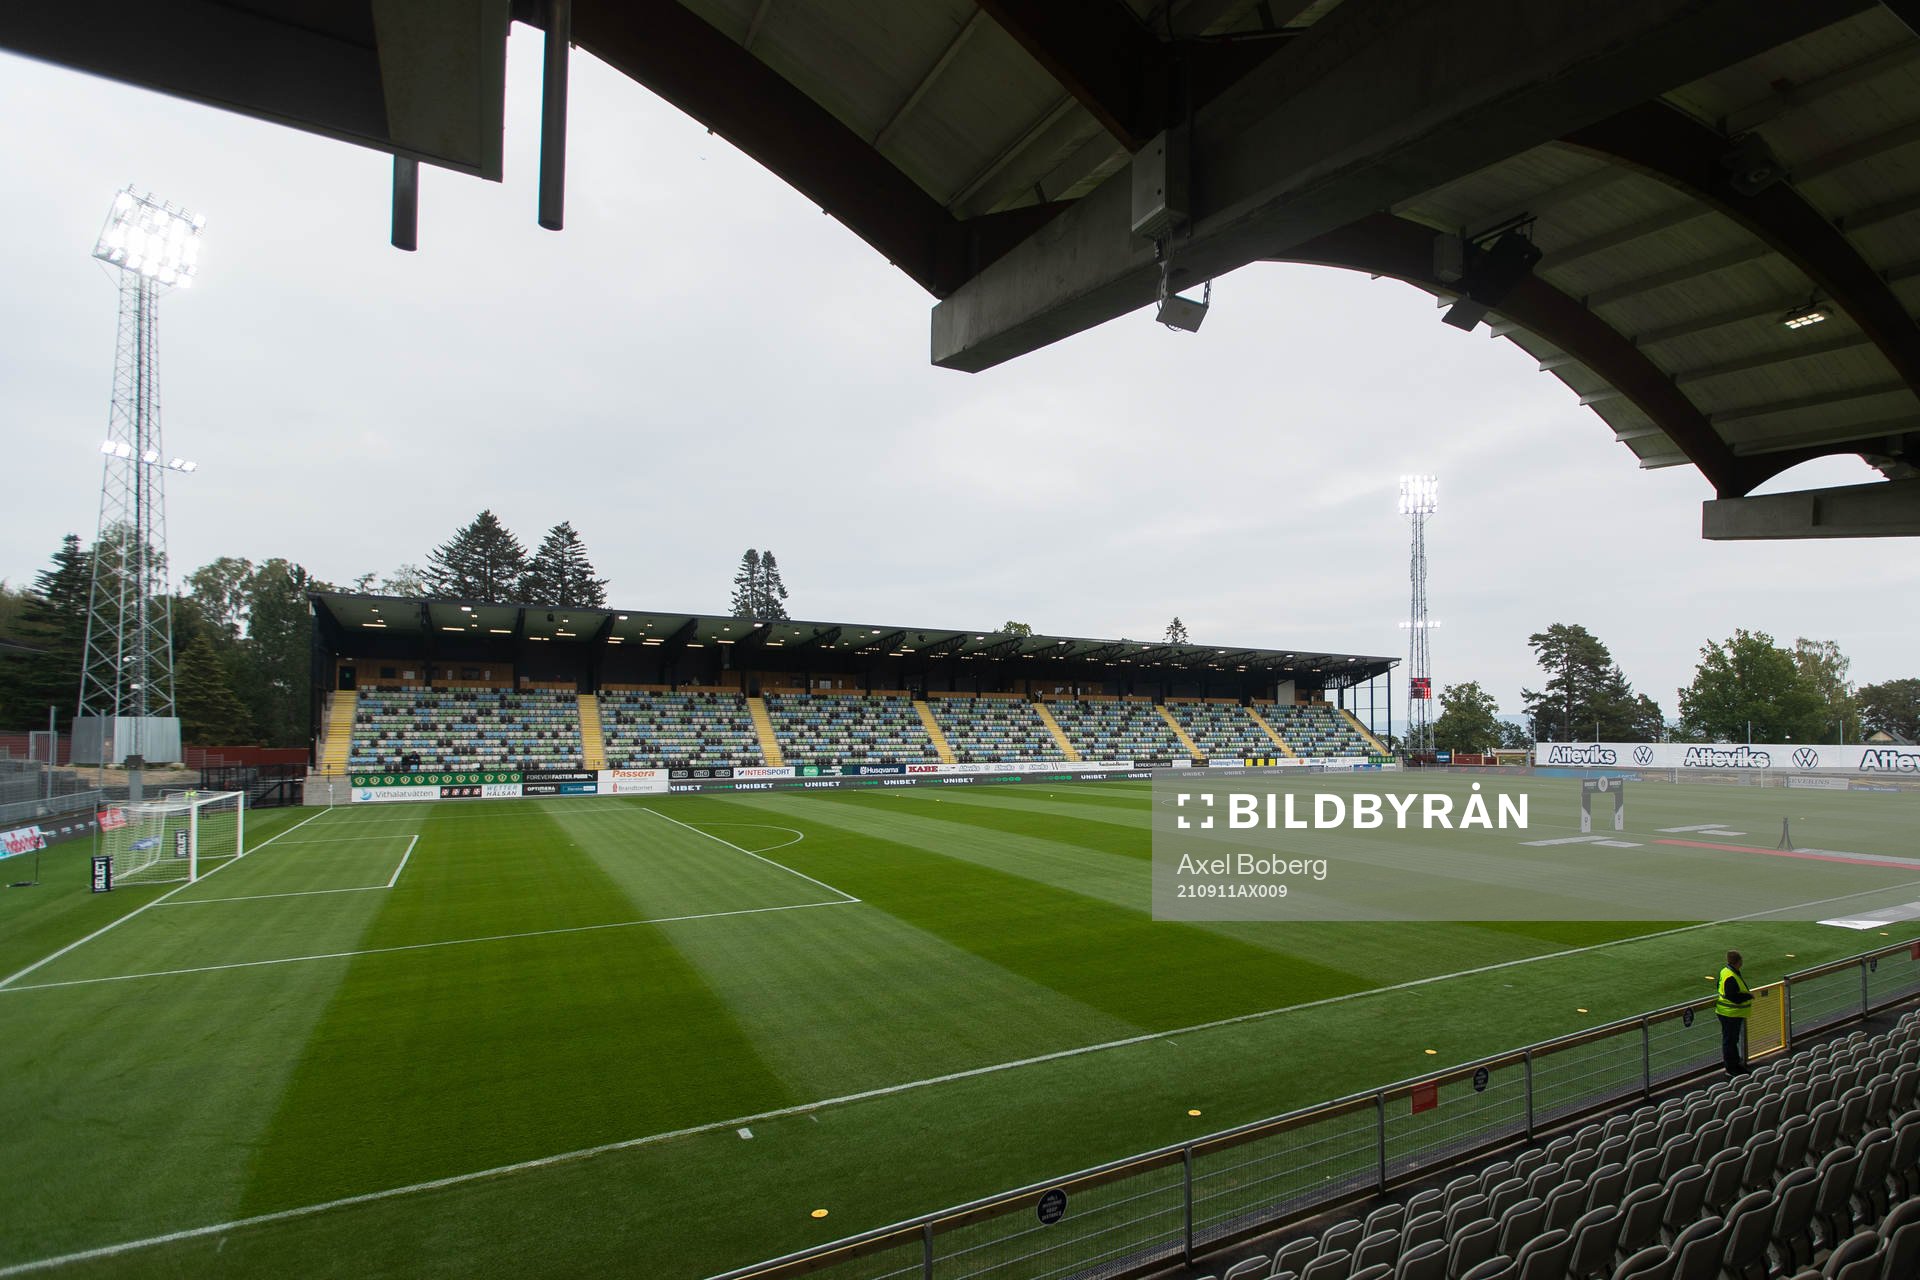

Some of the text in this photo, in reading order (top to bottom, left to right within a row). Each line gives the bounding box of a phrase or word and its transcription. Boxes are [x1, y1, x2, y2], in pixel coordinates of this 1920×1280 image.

[1549, 745, 1617, 764] Atteviks
[1684, 746, 1771, 768] Atteviks
[612, 769, 656, 778] Passera
[744, 768, 791, 776] INTERSPORT
[908, 765, 939, 773] KABE
[735, 782, 774, 790] UNIBET
[94, 860, 107, 890] SELECT
